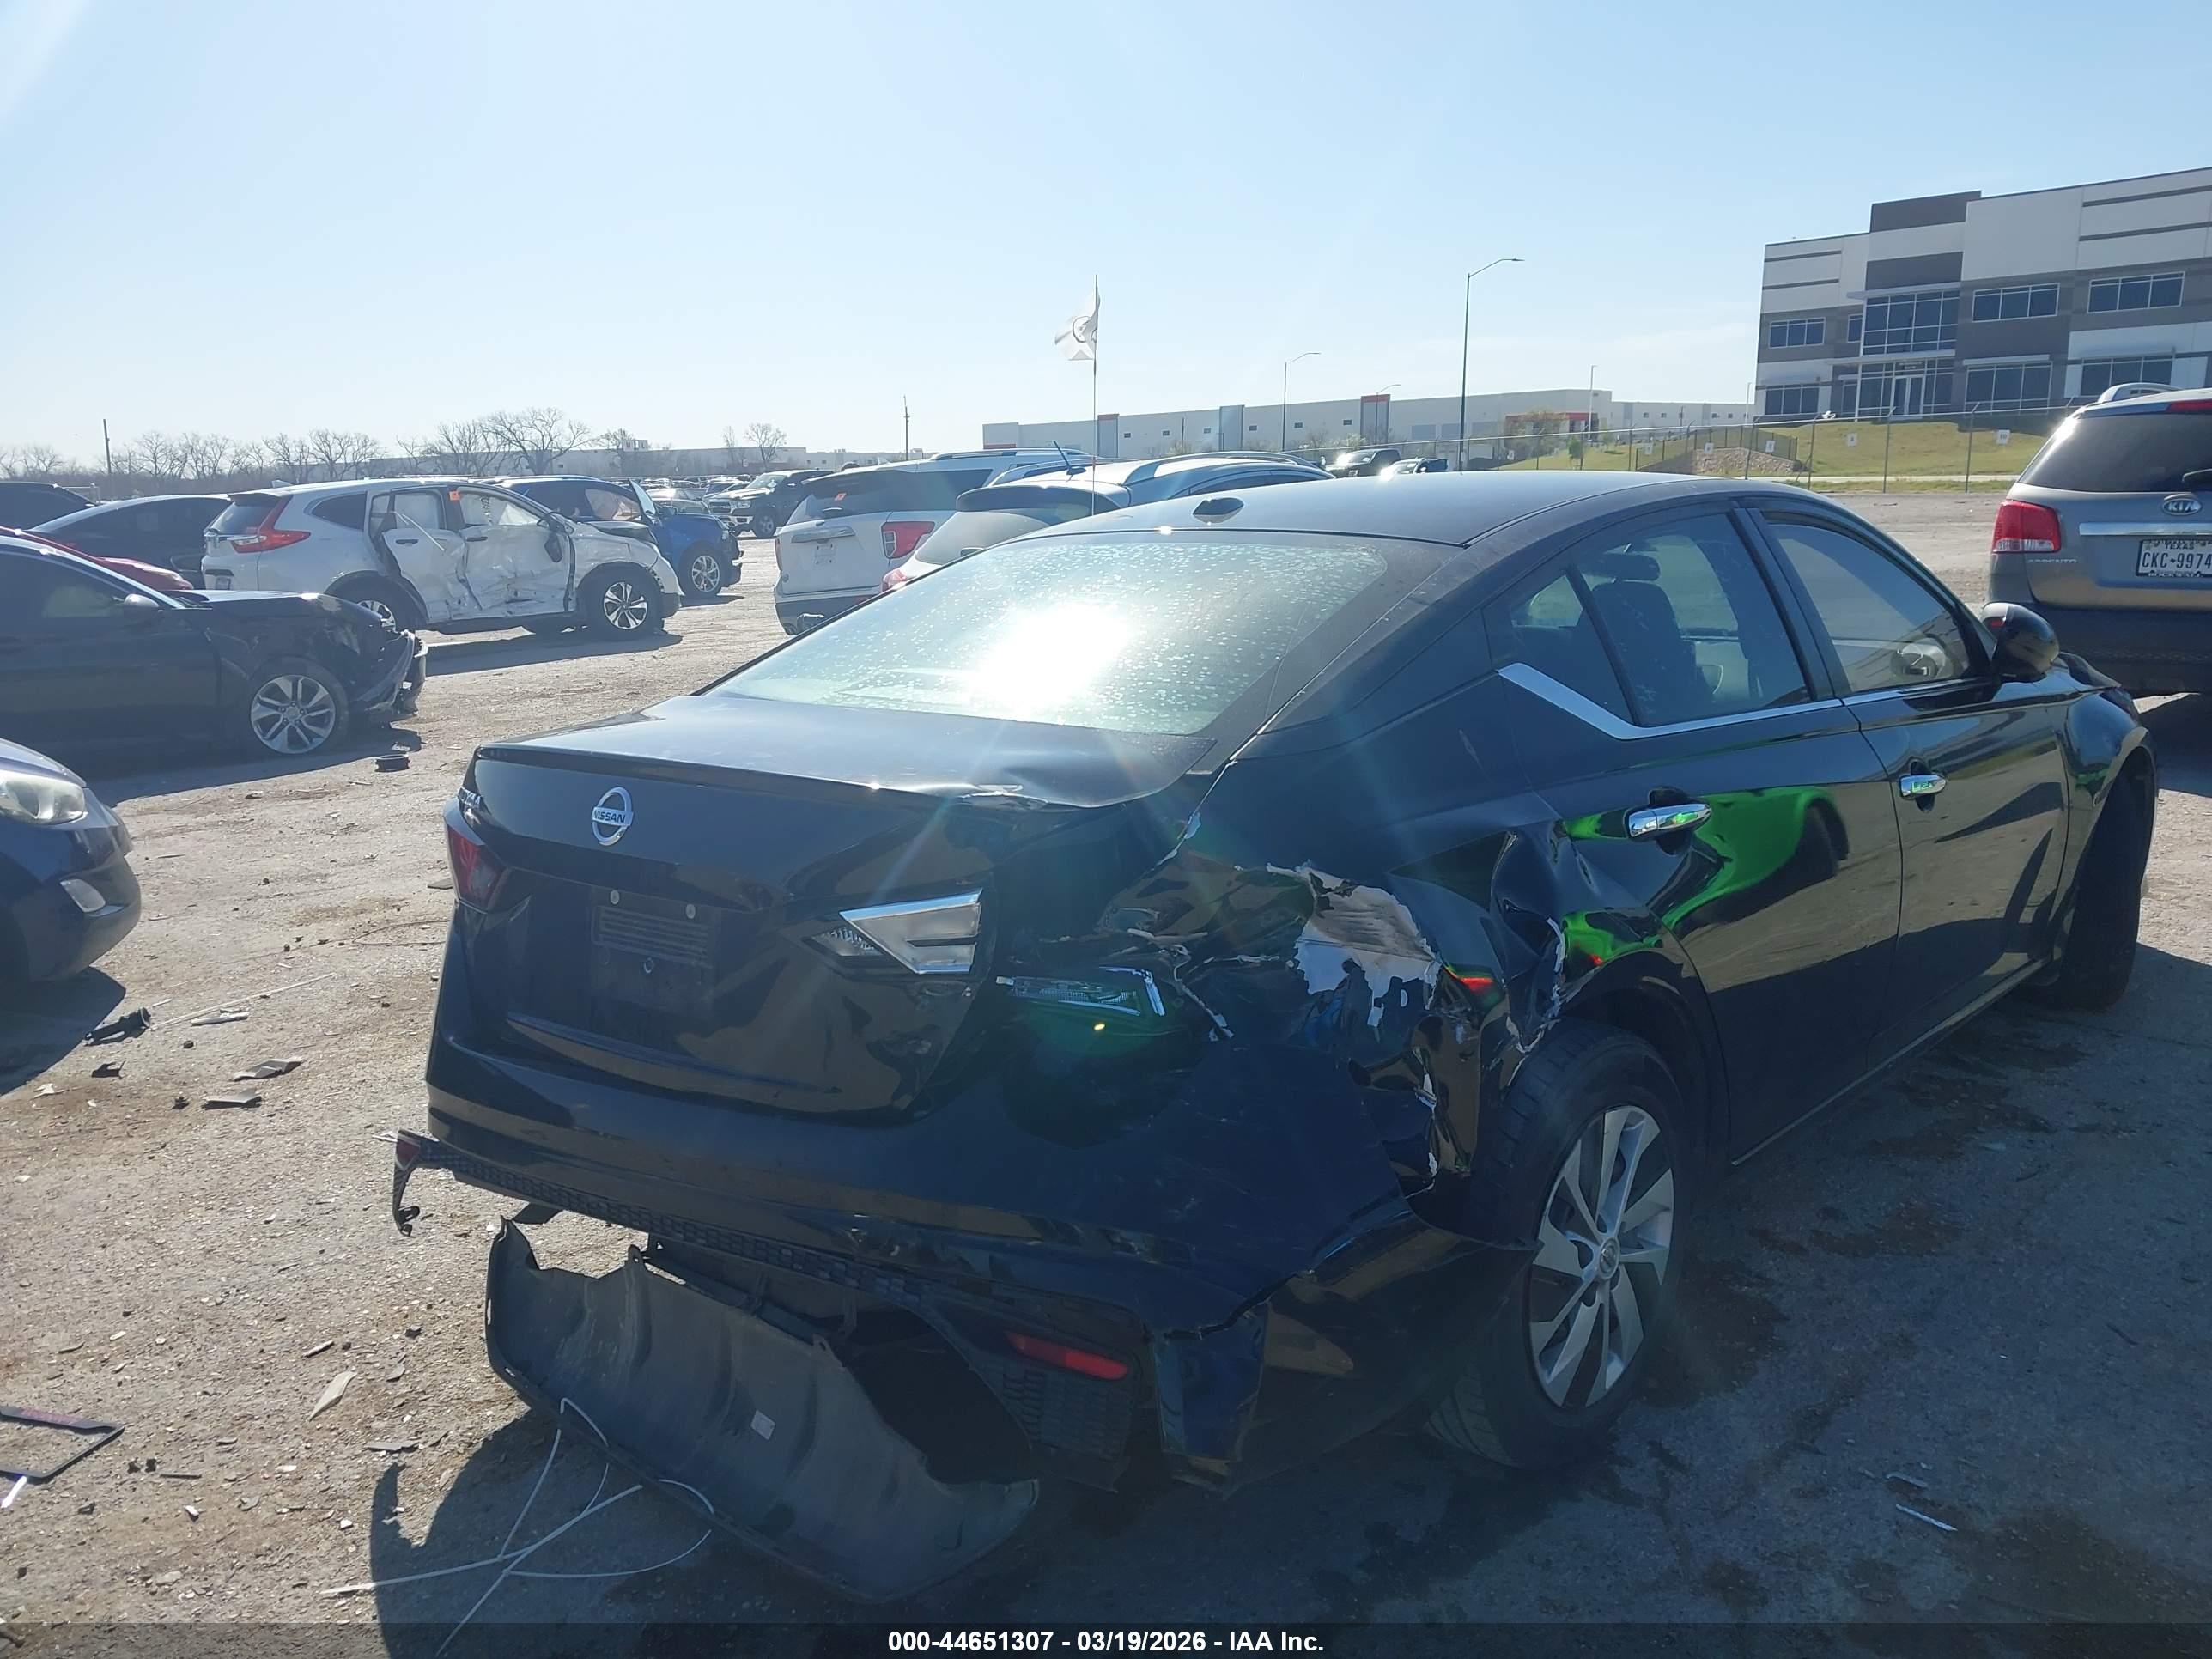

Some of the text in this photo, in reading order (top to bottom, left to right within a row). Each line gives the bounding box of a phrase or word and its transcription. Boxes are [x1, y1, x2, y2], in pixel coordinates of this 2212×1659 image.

[2168, 501, 2200, 512] KIA
[2165, 541, 2195, 550] TEXAS
[594, 810, 626, 823] NISSAN
